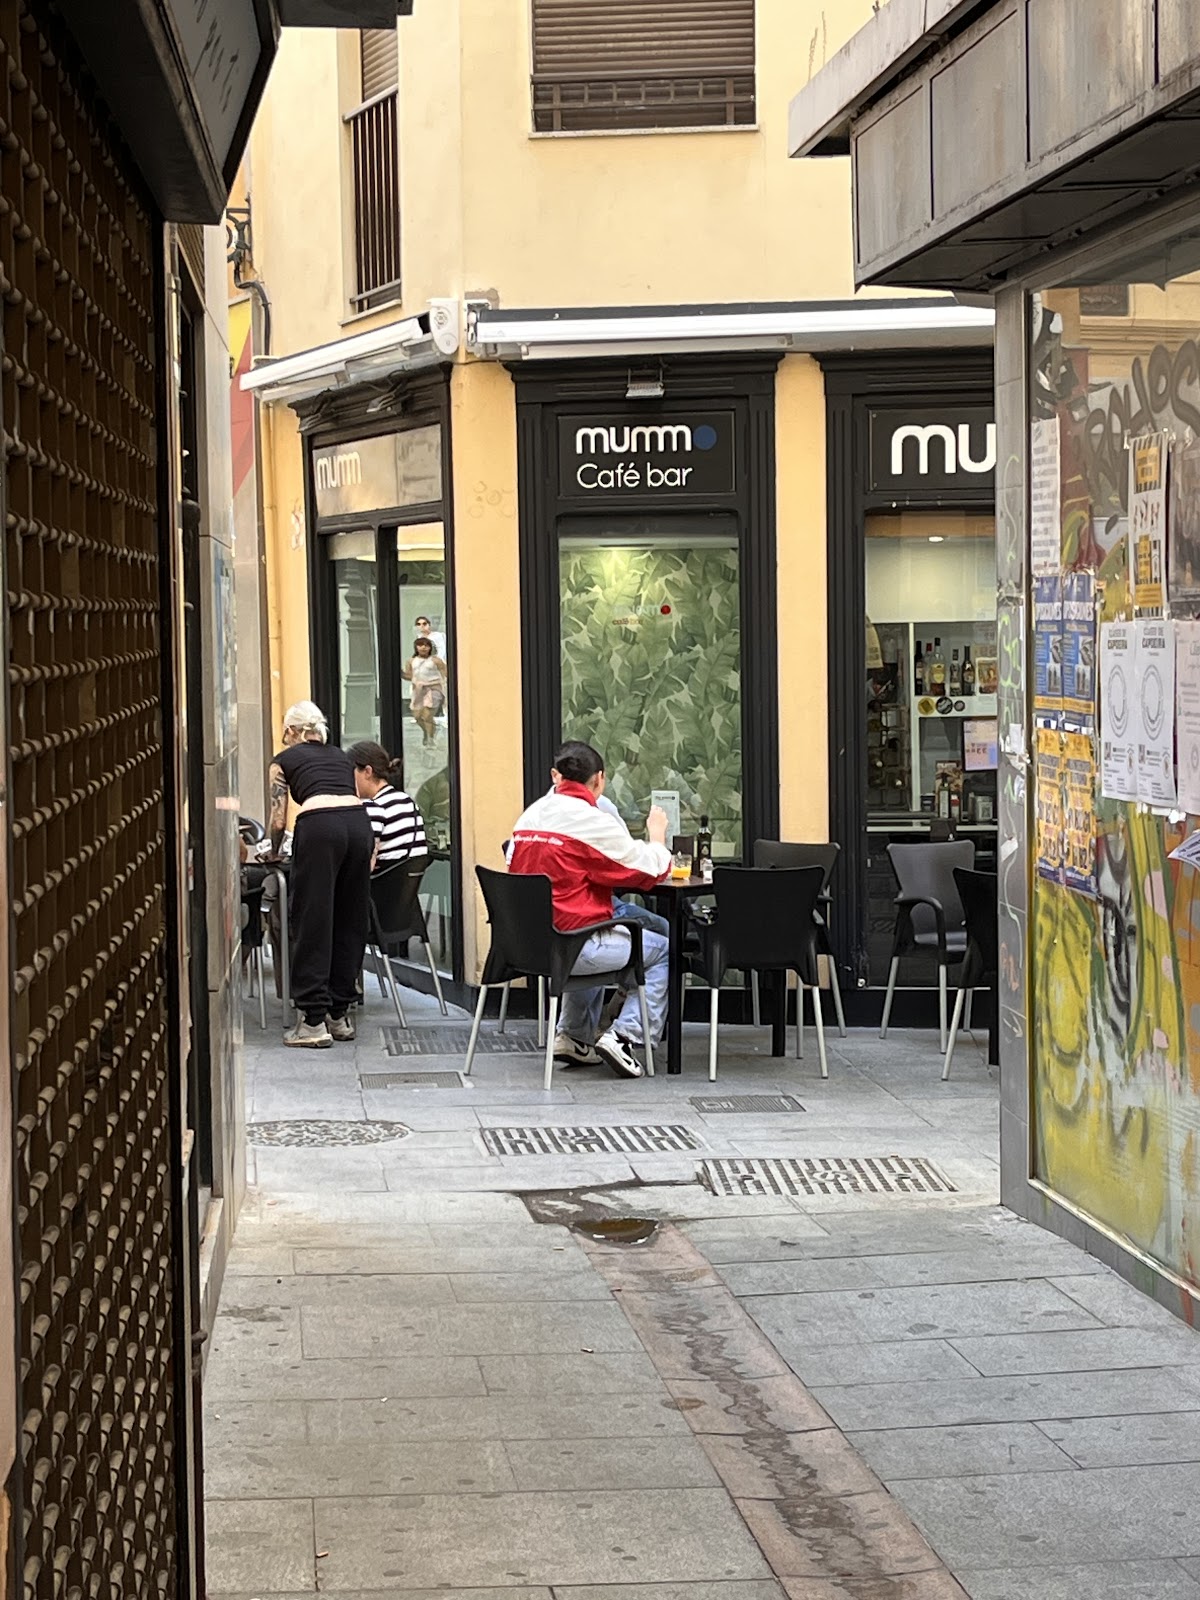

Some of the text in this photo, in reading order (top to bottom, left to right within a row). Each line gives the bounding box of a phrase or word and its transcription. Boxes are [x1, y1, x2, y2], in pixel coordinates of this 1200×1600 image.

[576, 425, 692, 454] mumm
[891, 423, 997, 474] mu
[316, 451, 361, 490] mumm
[577, 462, 693, 489] Café bar
